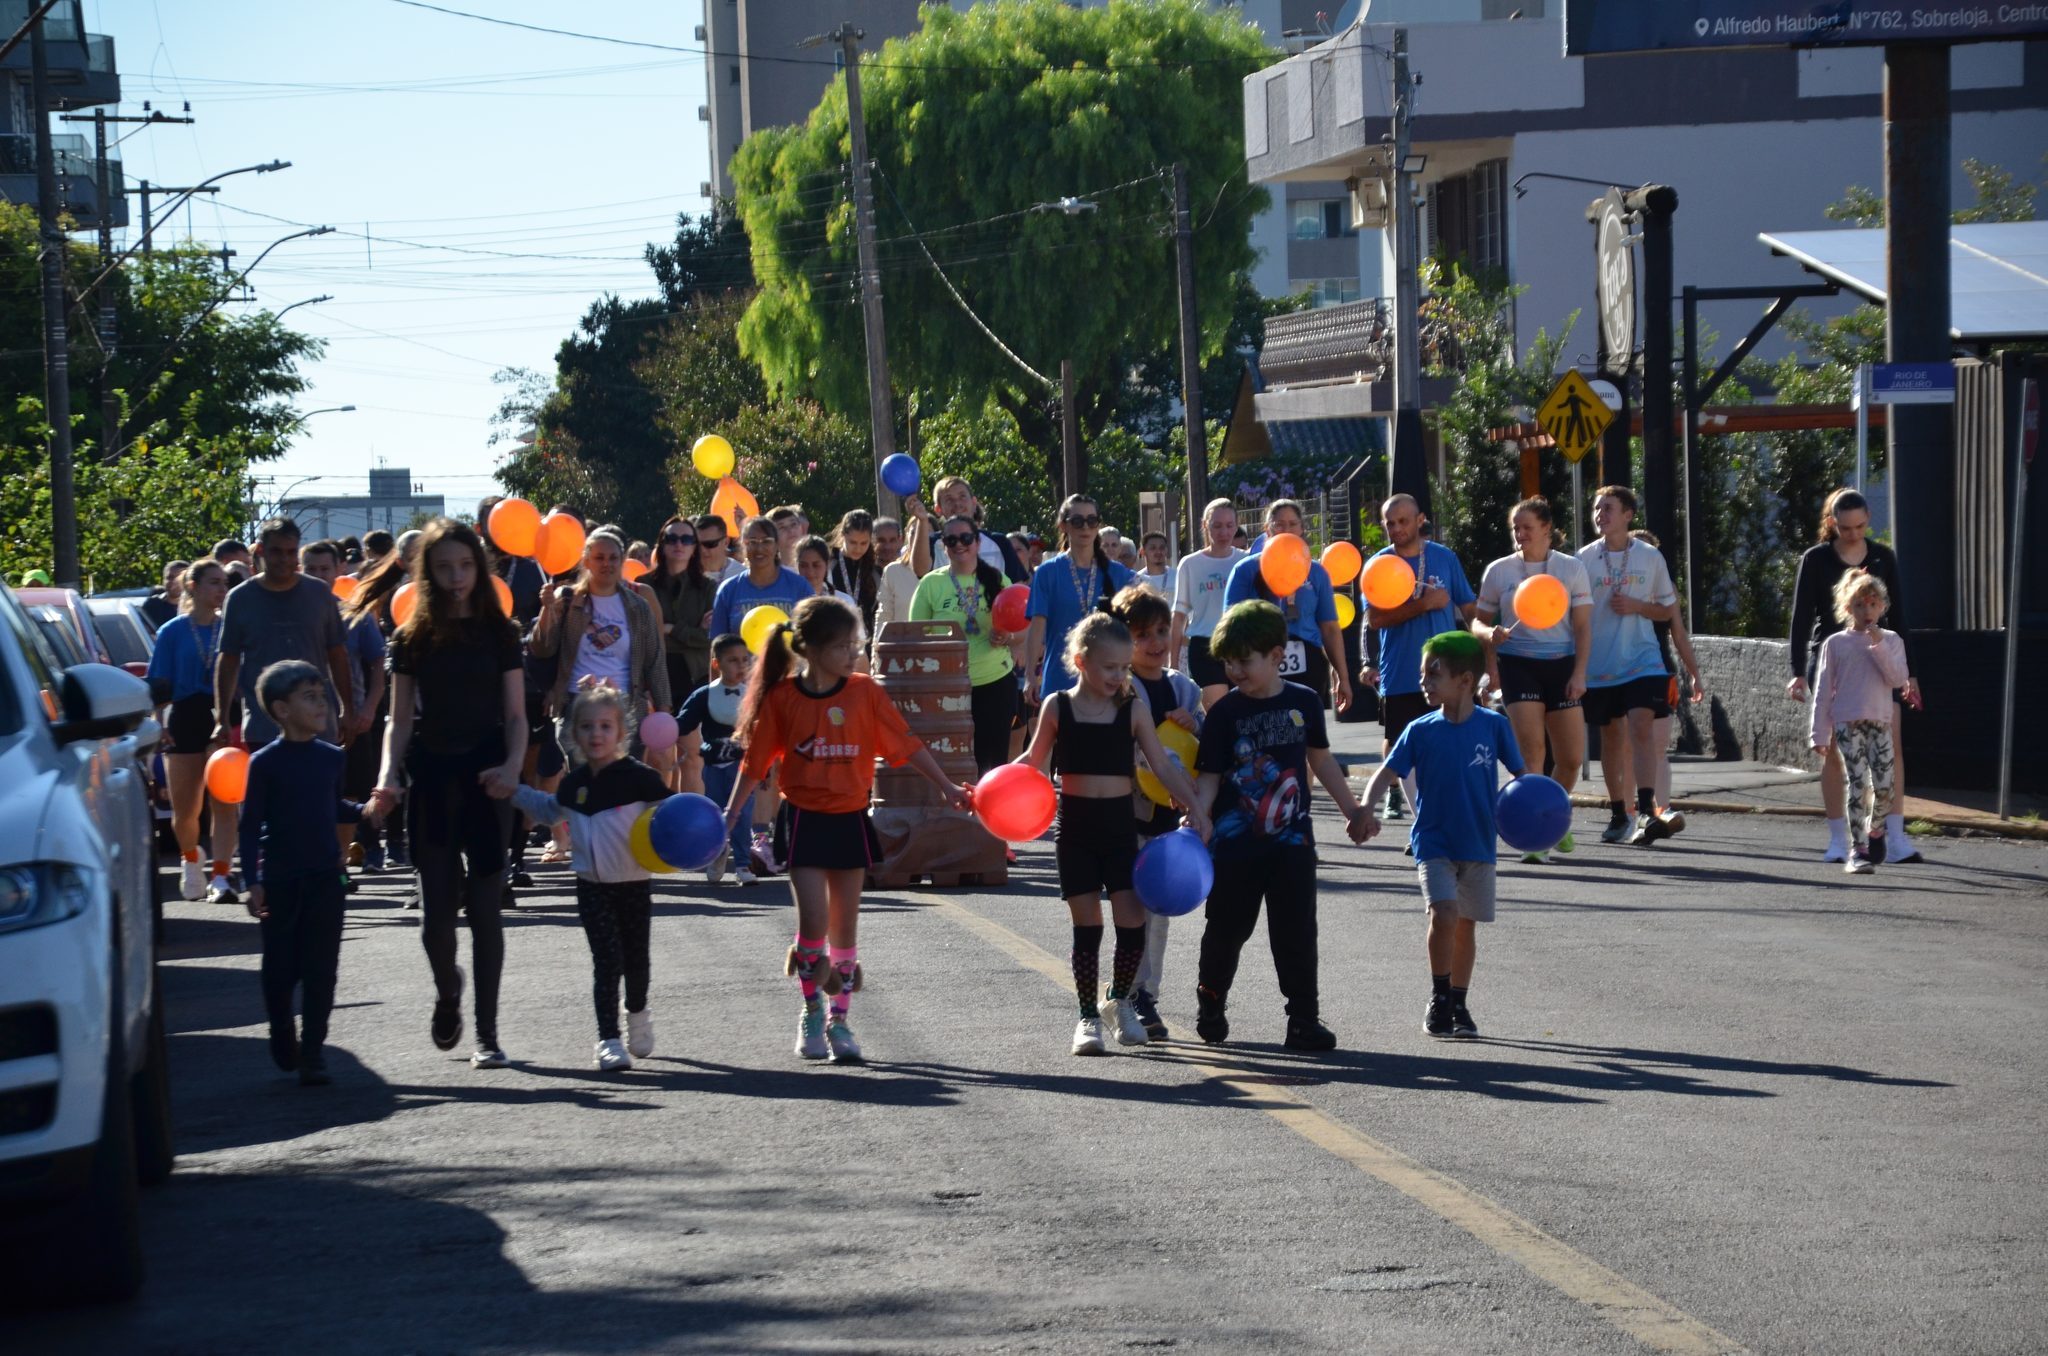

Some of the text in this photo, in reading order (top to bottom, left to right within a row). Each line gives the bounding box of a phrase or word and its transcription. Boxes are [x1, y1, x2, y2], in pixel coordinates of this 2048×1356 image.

[1714, 16, 1771, 35] Alfredo
[1850, 10, 1907, 30] N°762,
[1911, 6, 1993, 29] Sobreloja,
[1895, 371, 1928, 379] RIO DE
[1890, 380, 1933, 389] JANEIRO
